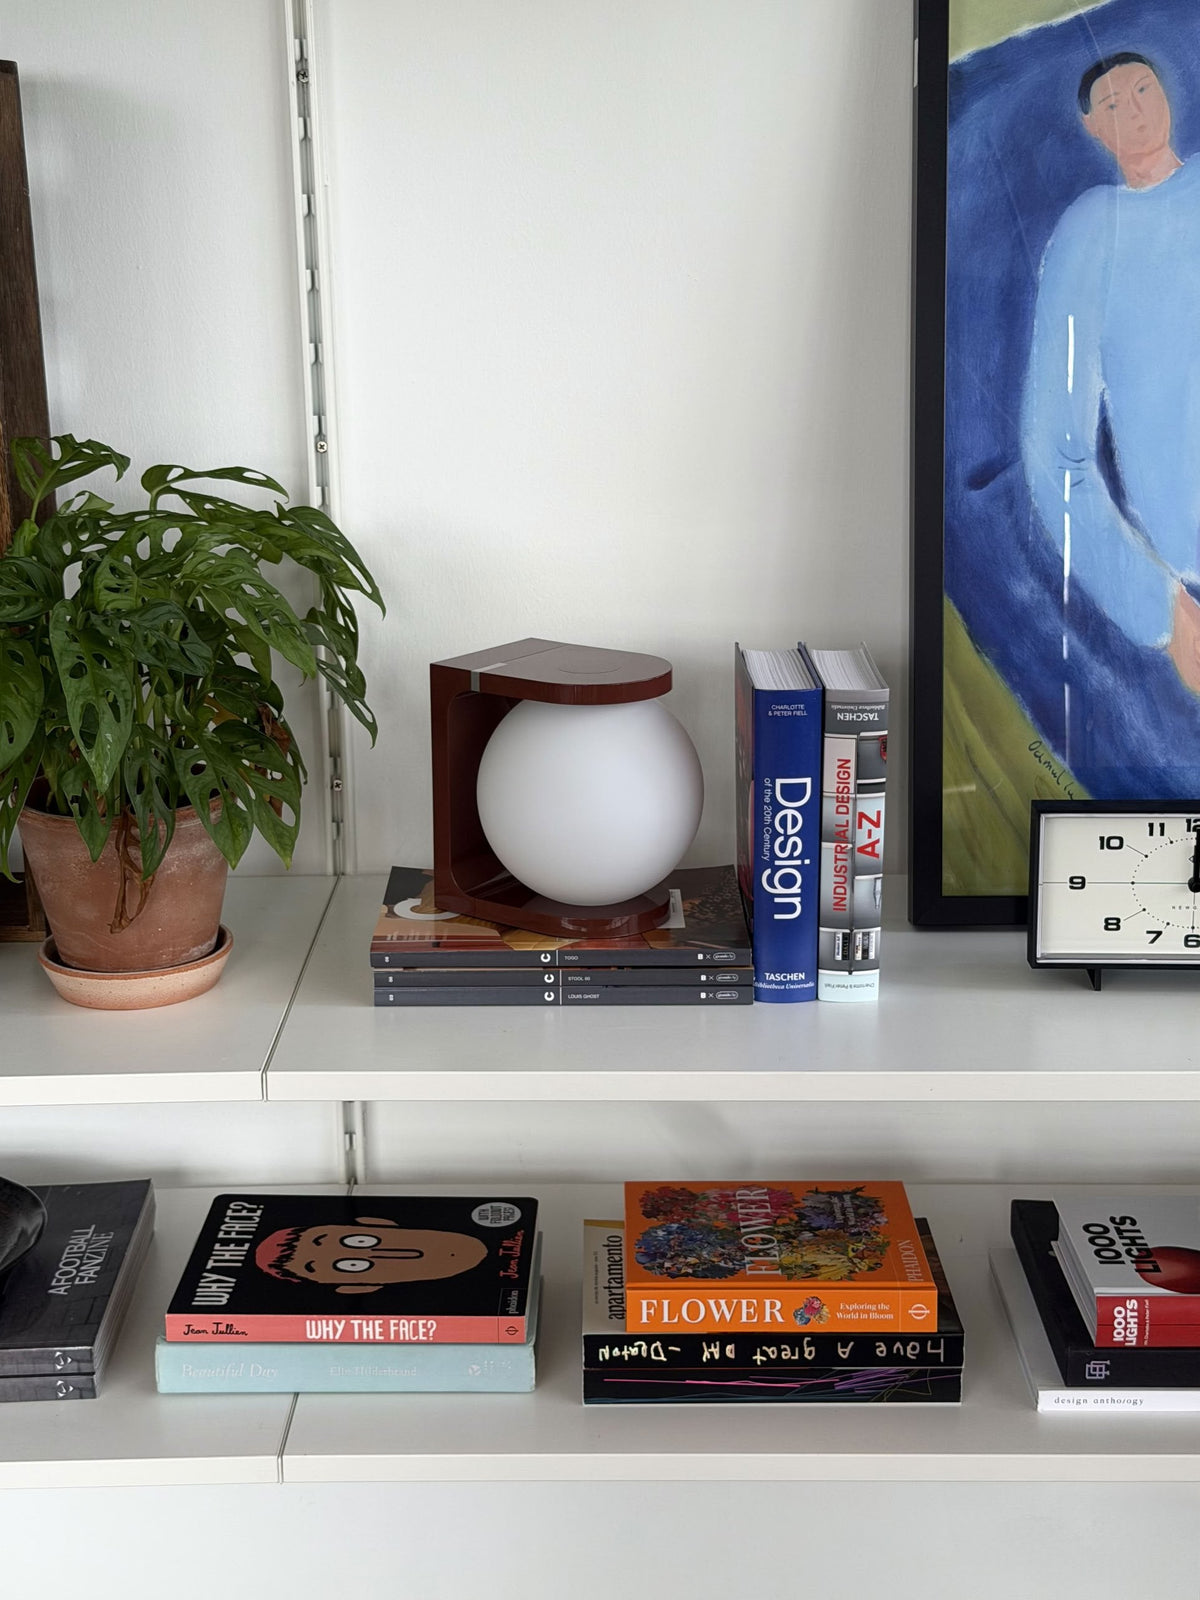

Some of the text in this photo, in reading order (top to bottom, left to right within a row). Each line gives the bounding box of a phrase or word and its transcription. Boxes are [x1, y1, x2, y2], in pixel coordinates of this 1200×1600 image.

[837, 712, 879, 721] TASCHEN
[835, 758, 851, 815] DESIGN
[761, 777, 773, 862] of the 20th Century
[1148, 822, 1165, 836] 11
[857, 810, 881, 860] A-Z
[1098, 835, 1124, 850] 10
[761, 777, 812, 920] Design
[833, 820, 850, 912] INDUSTRIAL
[1068, 875, 1086, 890] 9
[1103, 917, 1121, 931] 8
[1145, 930, 1163, 944] 7
[1183, 934, 1200, 948] 6
[764, 972, 805, 982] TASCHEN
[735, 1187, 782, 1275] FLOWER
[1083, 1223, 1126, 1265] 1000
[191, 1201, 264, 1305] WHY THE FACE?
[1109, 1216, 1162, 1273] LIGHTS
[74, 1231, 114, 1285] FANZINE
[499, 1258, 519, 1279] Jean
[897, 1239, 924, 1282] PHAIDON
[602, 1234, 627, 1320] apartamento
[640, 1298, 784, 1323] FLOWER
[836, 1312, 894, 1320] World in Bloom
[840, 1302, 890, 1311] Exploring the
[183, 1322, 248, 1336] Jean Jullien
[306, 1319, 437, 1341] WHY THE FACE?
[1113, 1306, 1126, 1342] 1000
[1125, 1298, 1138, 1346] LIGHTS
[752, 1336, 816, 1365] great
[875, 1337, 945, 1363] have
[1054, 1396, 1144, 1406] design anthology
